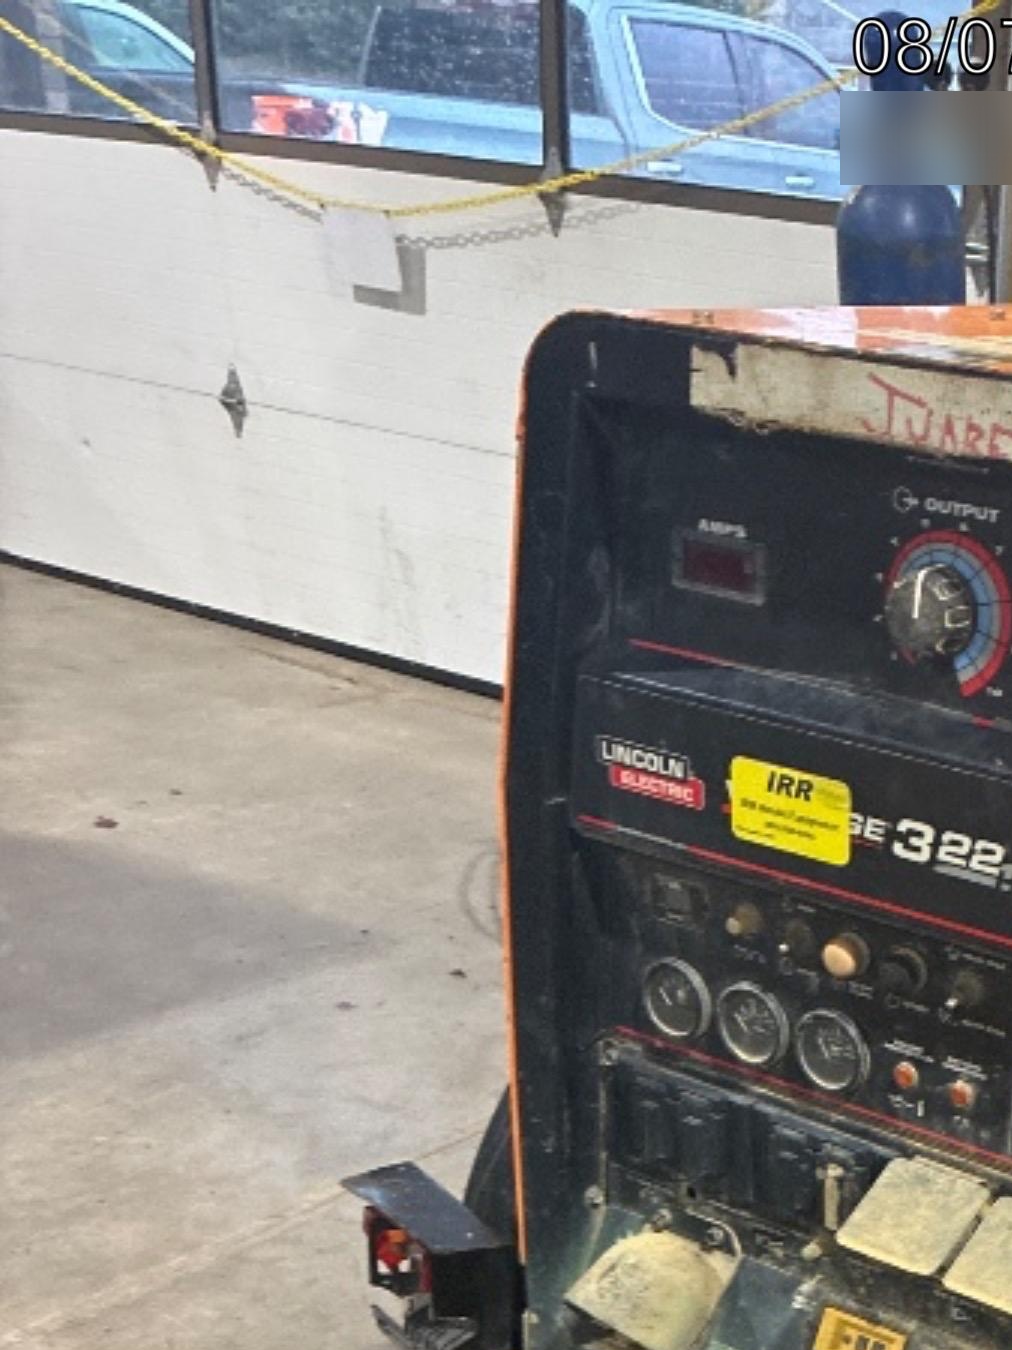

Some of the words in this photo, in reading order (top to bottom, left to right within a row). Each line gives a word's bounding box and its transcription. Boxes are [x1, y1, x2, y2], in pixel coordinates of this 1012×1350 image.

[923, 496, 1001, 524] OUTPUT
[600, 738, 686, 780] LINCOLN
[619, 769, 696, 803] ELECTRIC
[767, 769, 815, 802] IRR
[891, 817, 1008, 879] 322
